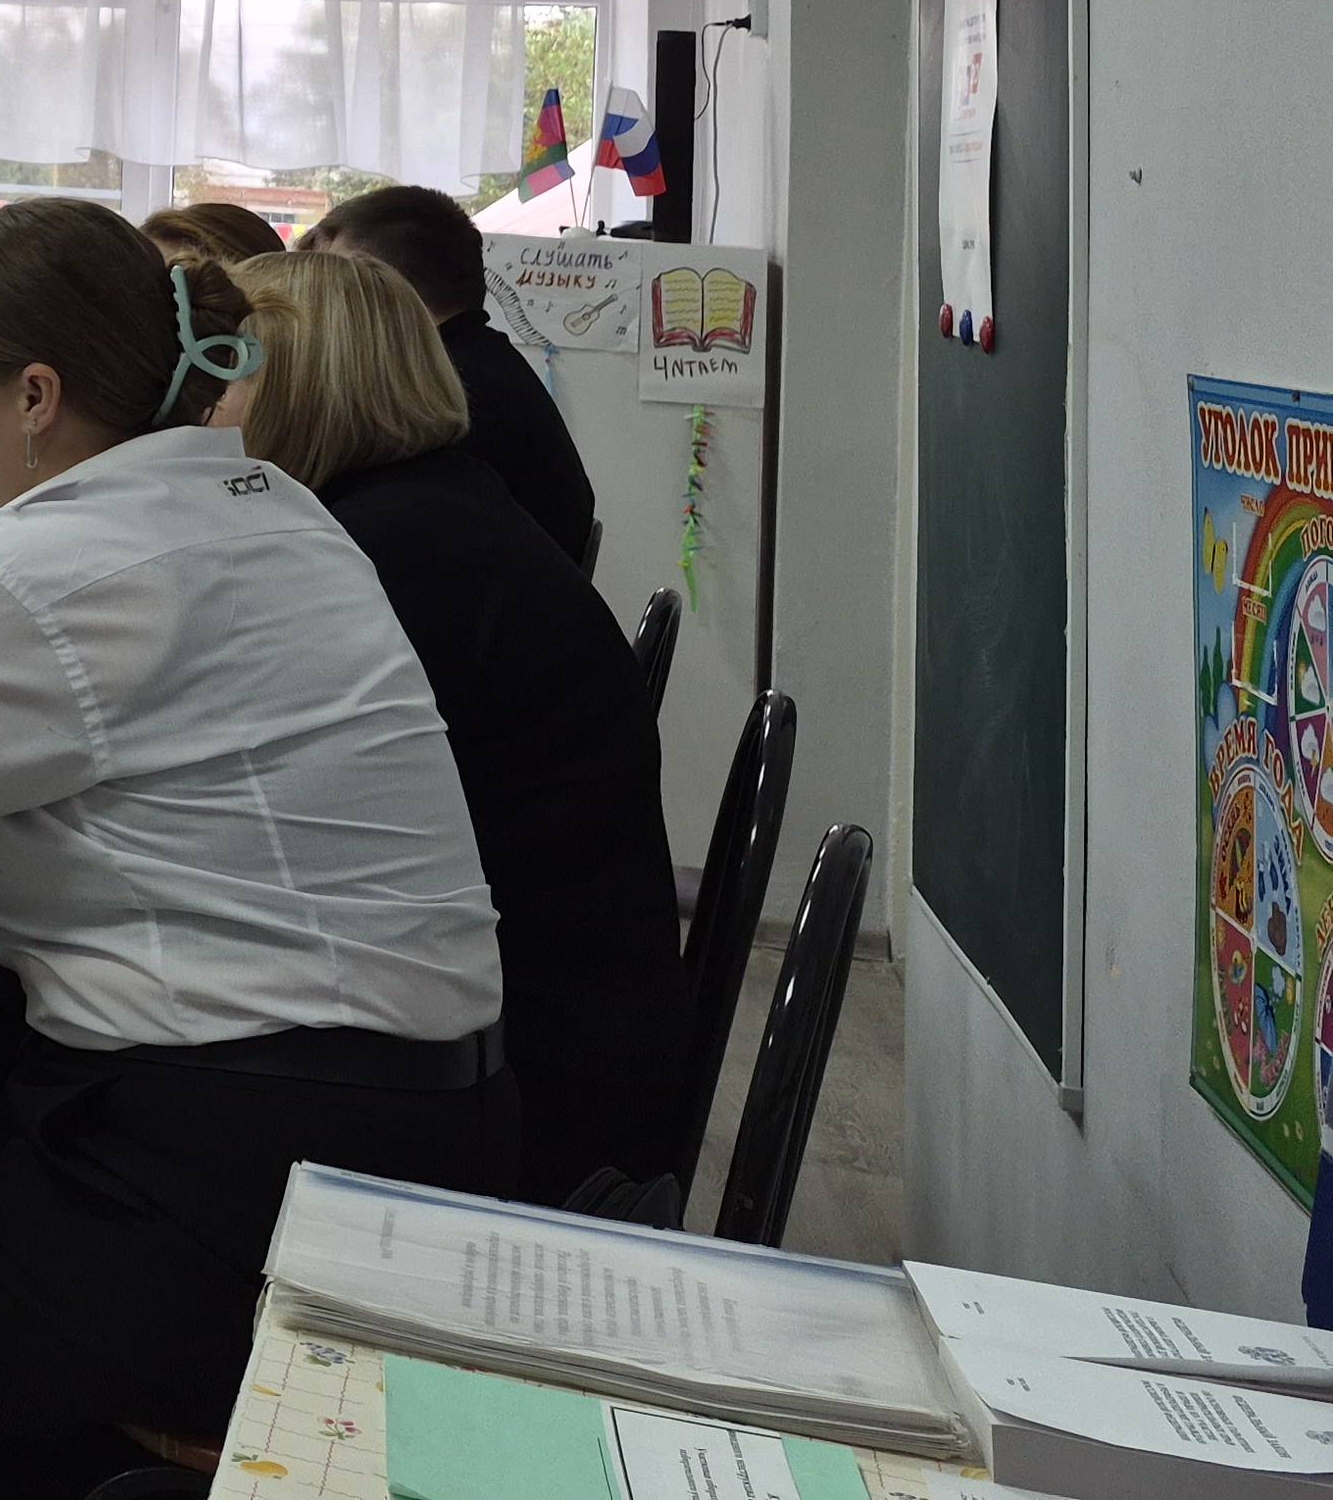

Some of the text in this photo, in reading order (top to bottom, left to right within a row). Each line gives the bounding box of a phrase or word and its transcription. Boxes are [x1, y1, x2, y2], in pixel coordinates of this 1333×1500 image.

[1197, 400, 1333, 500] УГОЛОК ПРИ
[1209, 716, 1258, 806] ВРЕМЯ
